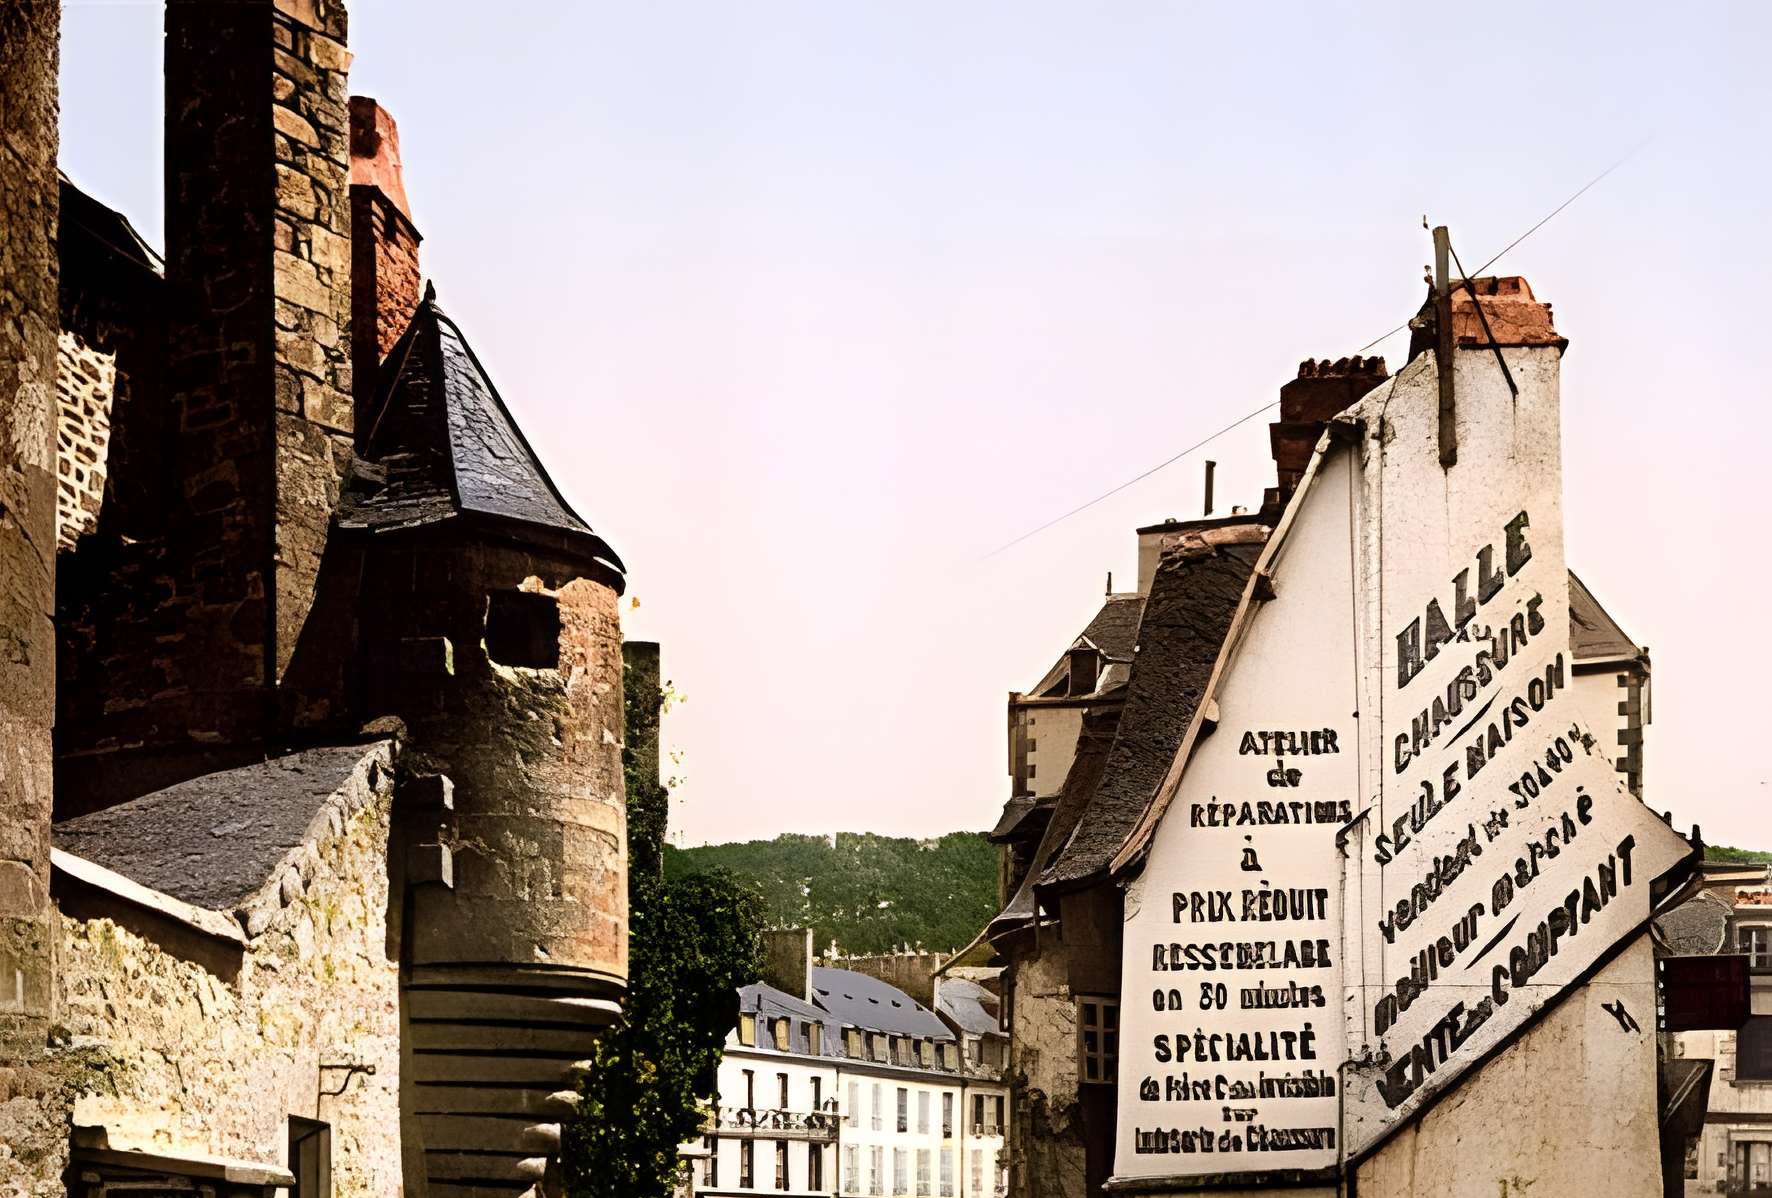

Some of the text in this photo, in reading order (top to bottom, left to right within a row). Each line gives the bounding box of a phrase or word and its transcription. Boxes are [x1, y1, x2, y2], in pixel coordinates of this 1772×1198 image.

[1396, 510, 1532, 689] HALLE
[1239, 728, 1340, 756] ATELIER
[1374, 759, 1462, 865] SEULE
[1172, 891, 1235, 924] PRIX
